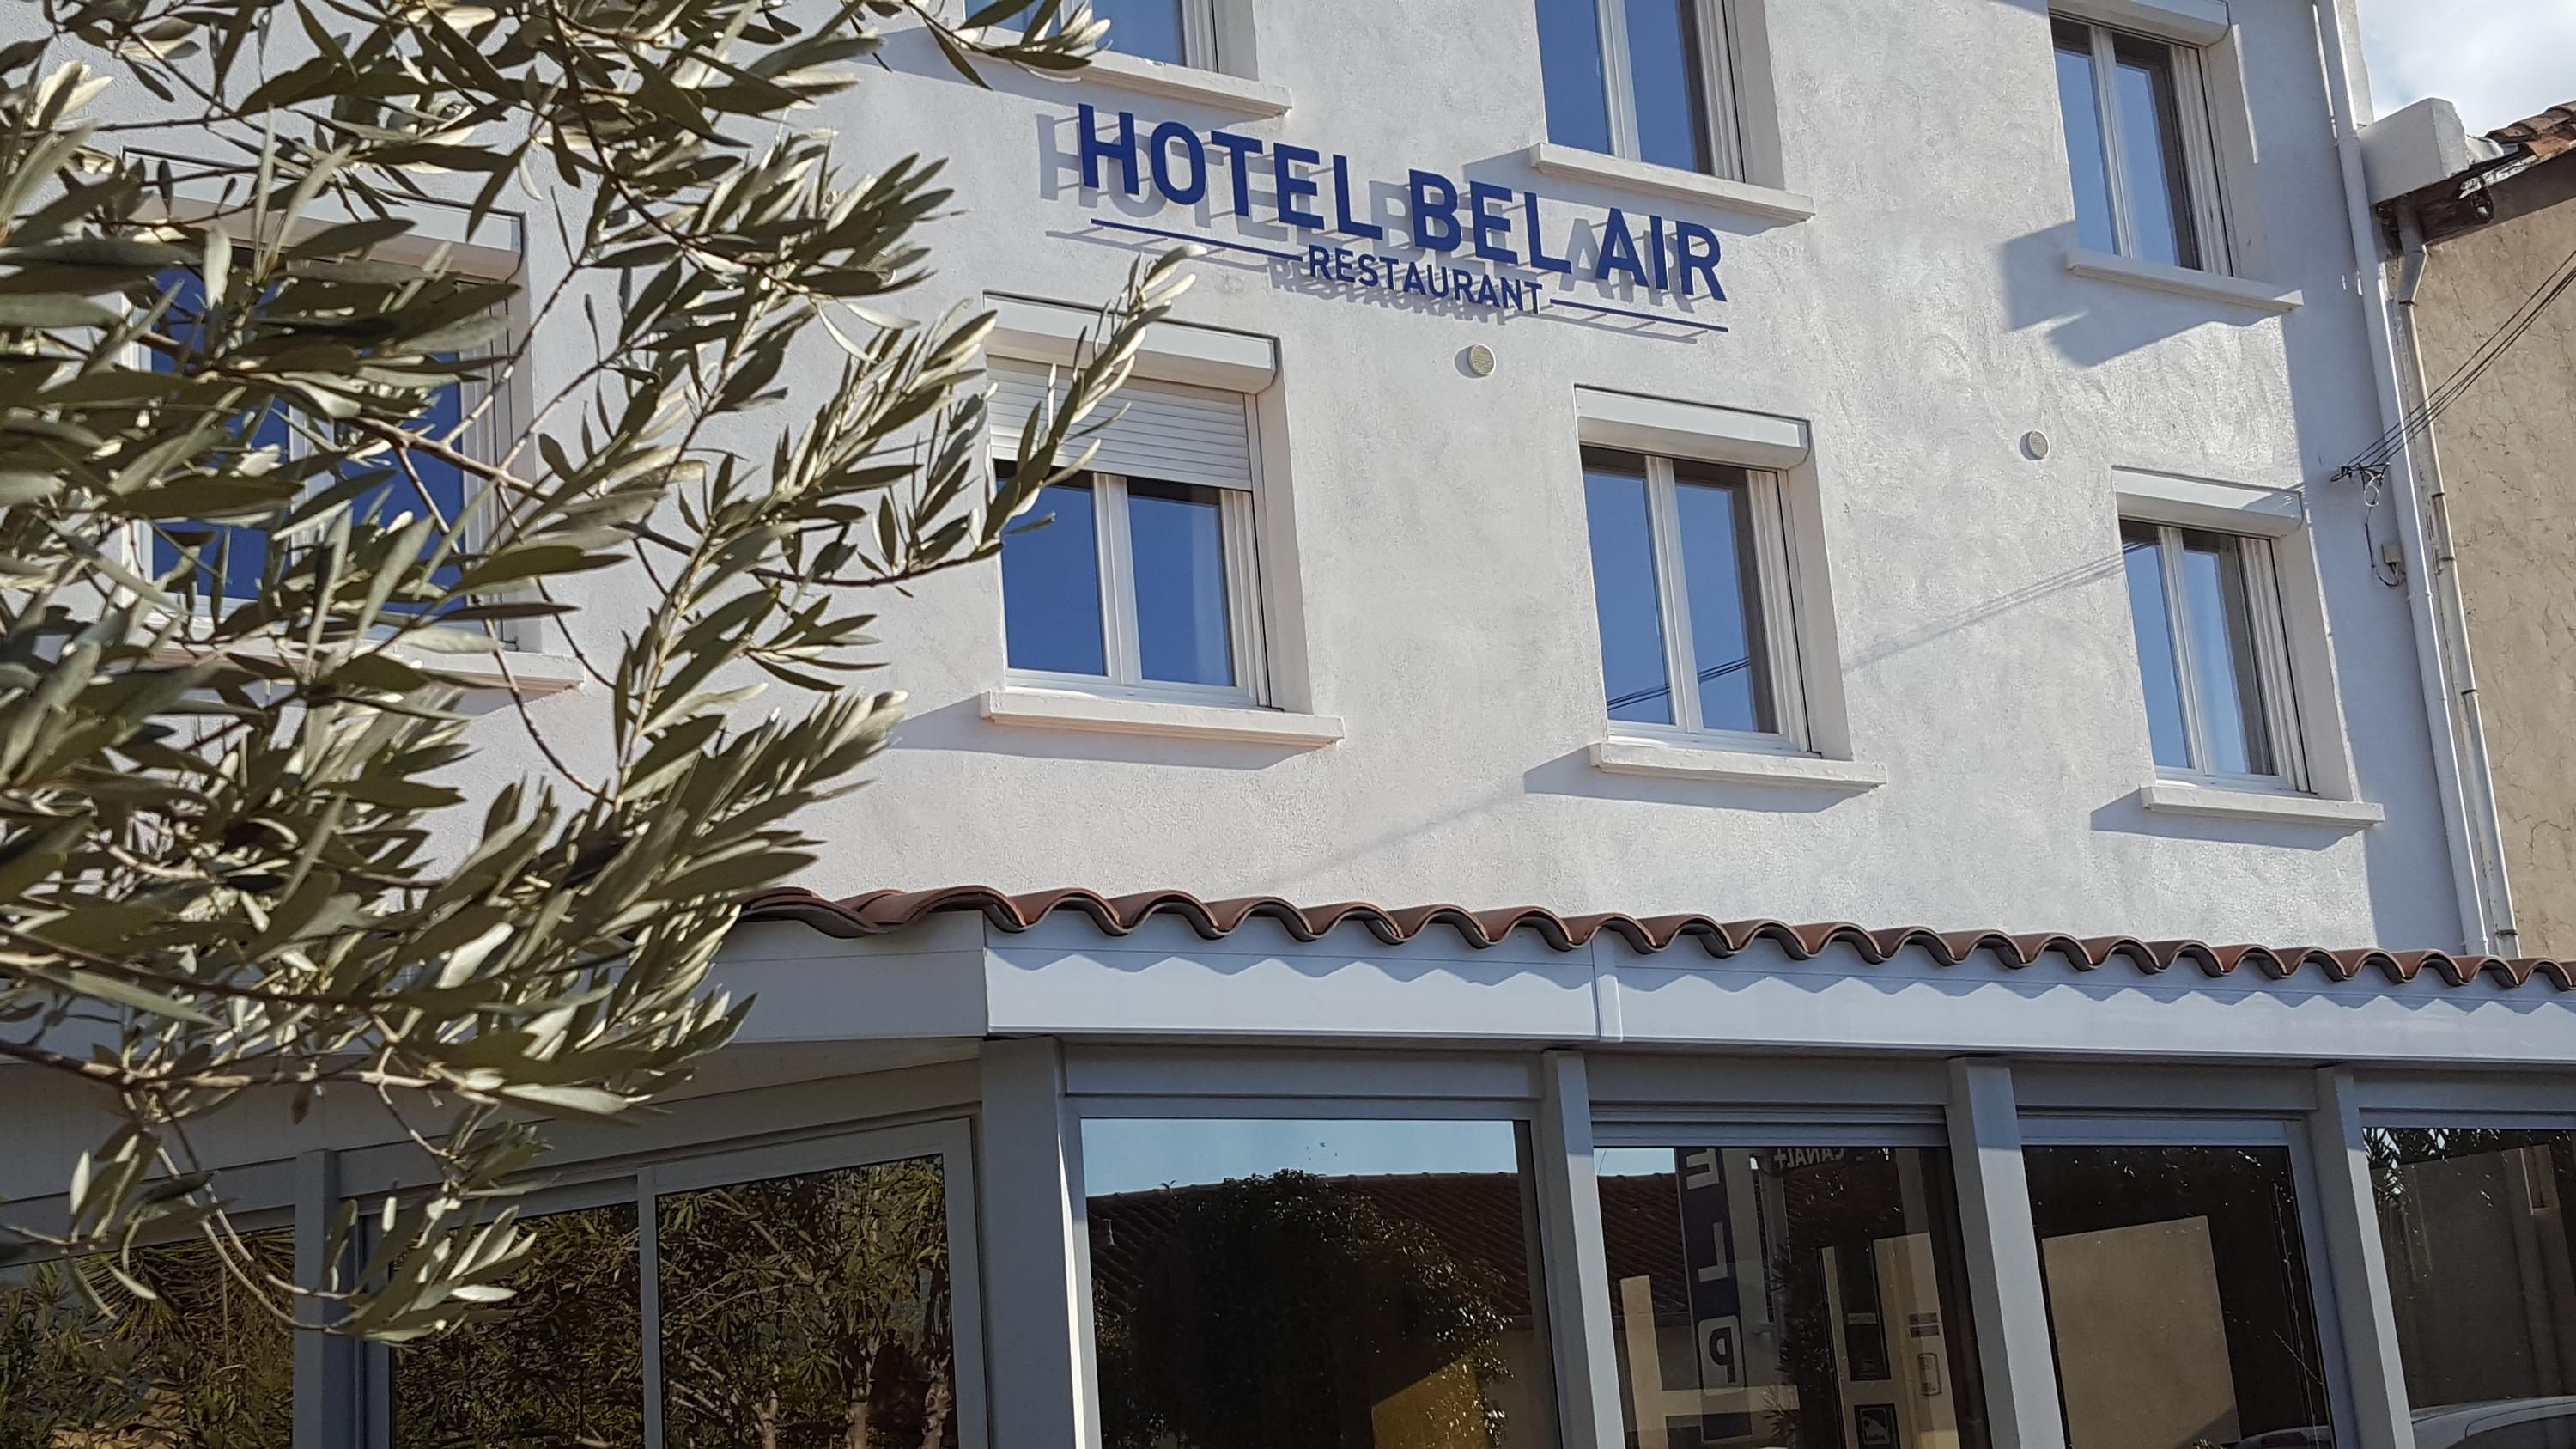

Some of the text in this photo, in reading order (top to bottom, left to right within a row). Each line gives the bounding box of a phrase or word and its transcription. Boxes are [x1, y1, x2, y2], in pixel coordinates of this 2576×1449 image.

[1078, 103, 1728, 301] HOTEL BEL AIR
[1308, 244, 1543, 314] RESTAURANT
